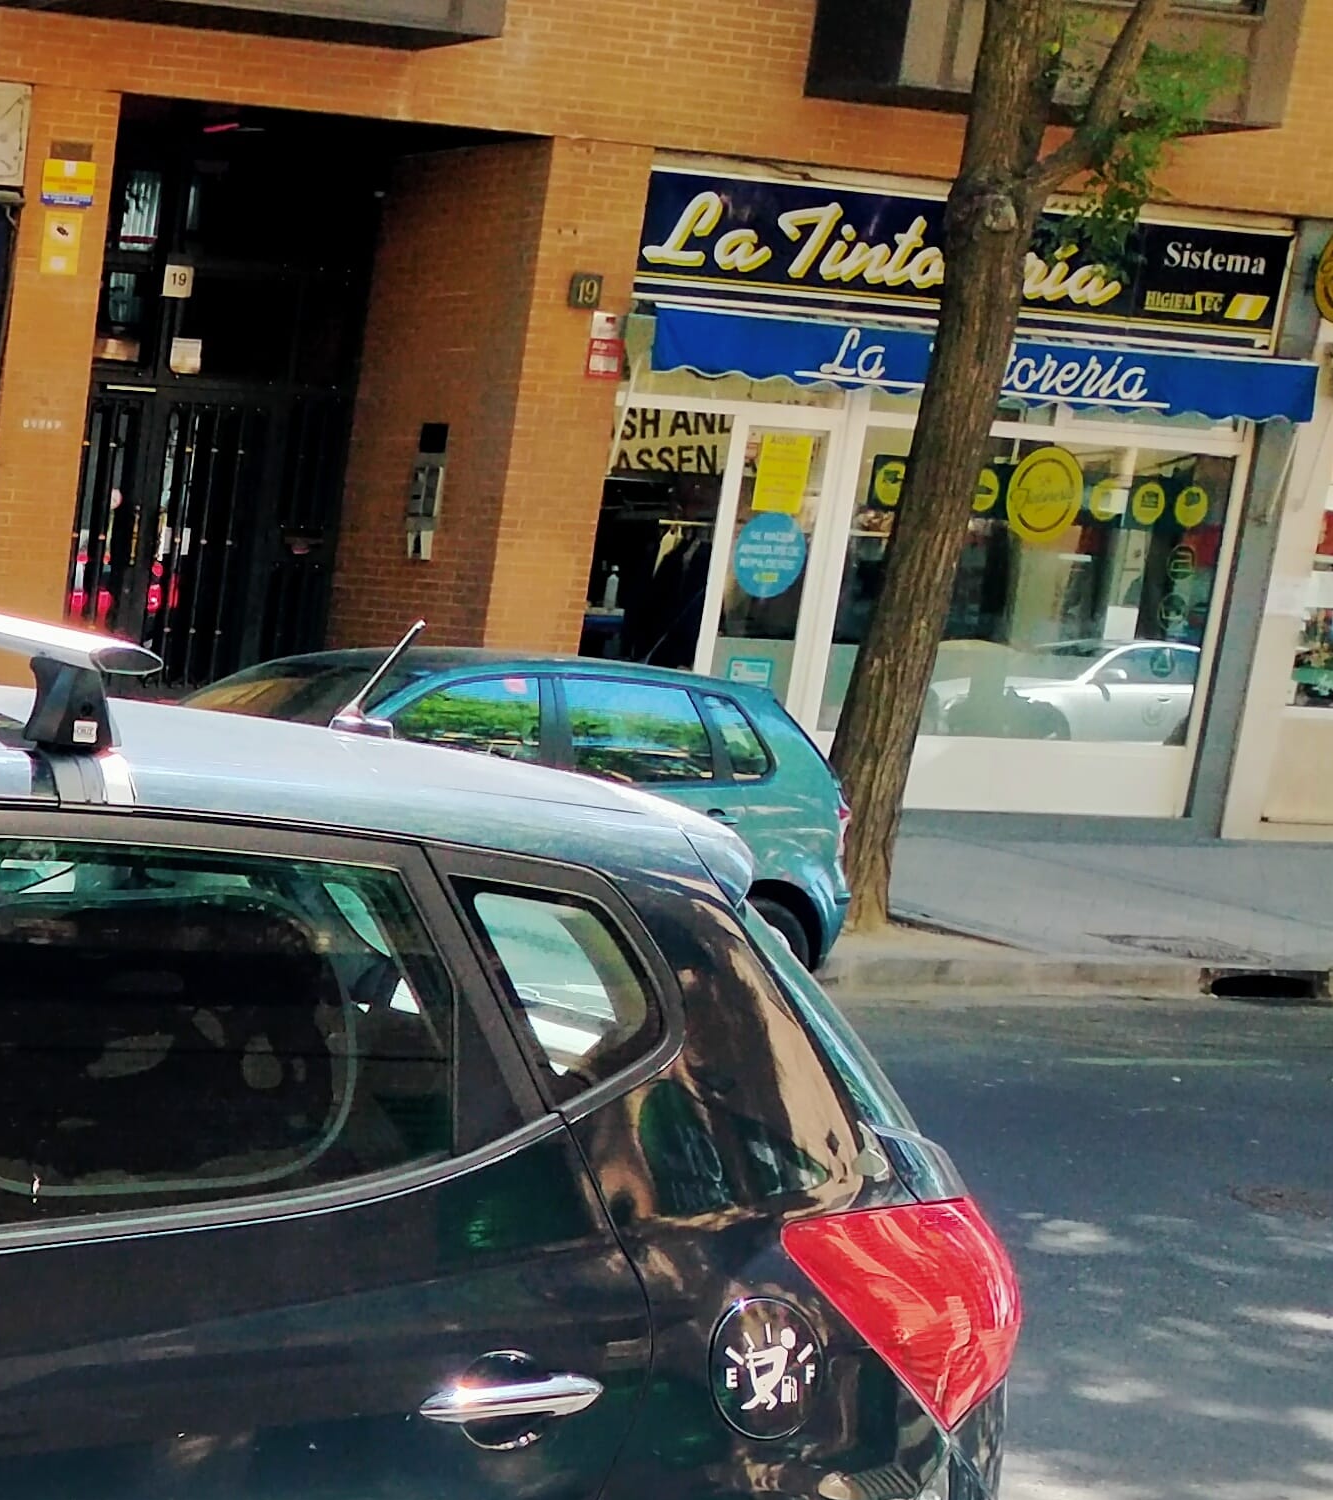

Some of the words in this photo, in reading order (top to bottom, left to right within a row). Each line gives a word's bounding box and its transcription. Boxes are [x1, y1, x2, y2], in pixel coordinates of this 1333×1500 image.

[642, 191, 772, 272] La
[778, 202, 1122, 306] Tintoría
[1164, 241, 1266, 275] Sistema
[171, 272, 187, 286] 19
[577, 279, 599, 303] 19
[820, 327, 885, 379] La
[930, 342, 1148, 399] torería
[614, 407, 661, 440] SH
[726, 1367, 738, 1388] E
[805, 1364, 815, 1384] F
